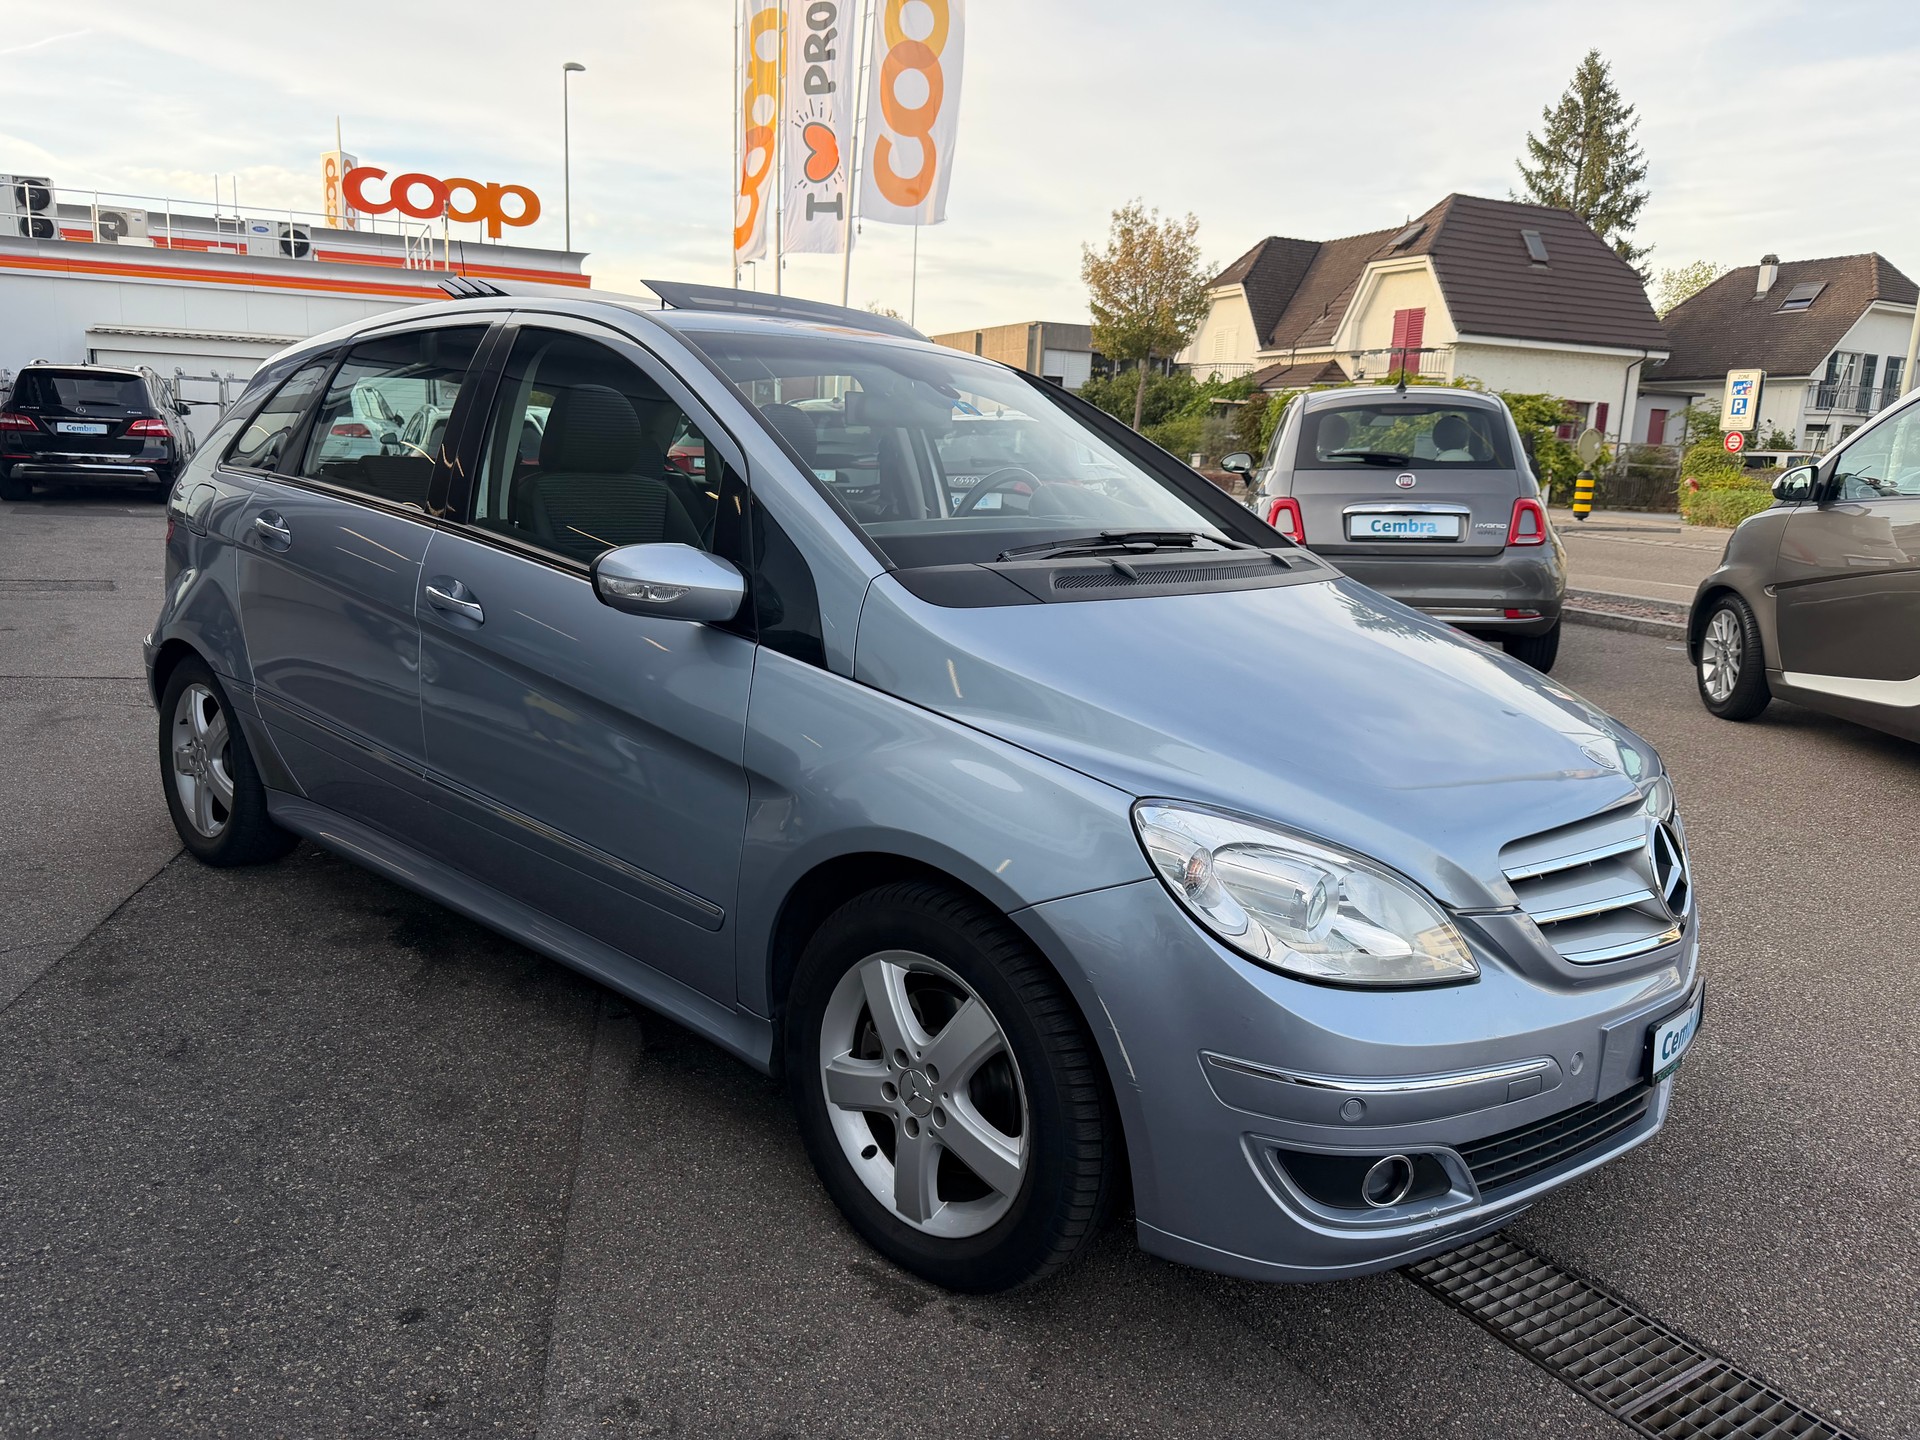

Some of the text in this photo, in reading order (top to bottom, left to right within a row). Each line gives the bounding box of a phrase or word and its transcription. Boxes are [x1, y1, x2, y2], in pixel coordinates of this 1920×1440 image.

[804, 0, 843, 221] I PRO
[873, 0, 950, 207] coo
[325, 158, 339, 230] oop
[342, 167, 541, 238] coop
[66, 424, 97, 432] Cembra
[1371, 519, 1437, 533] Cembra
